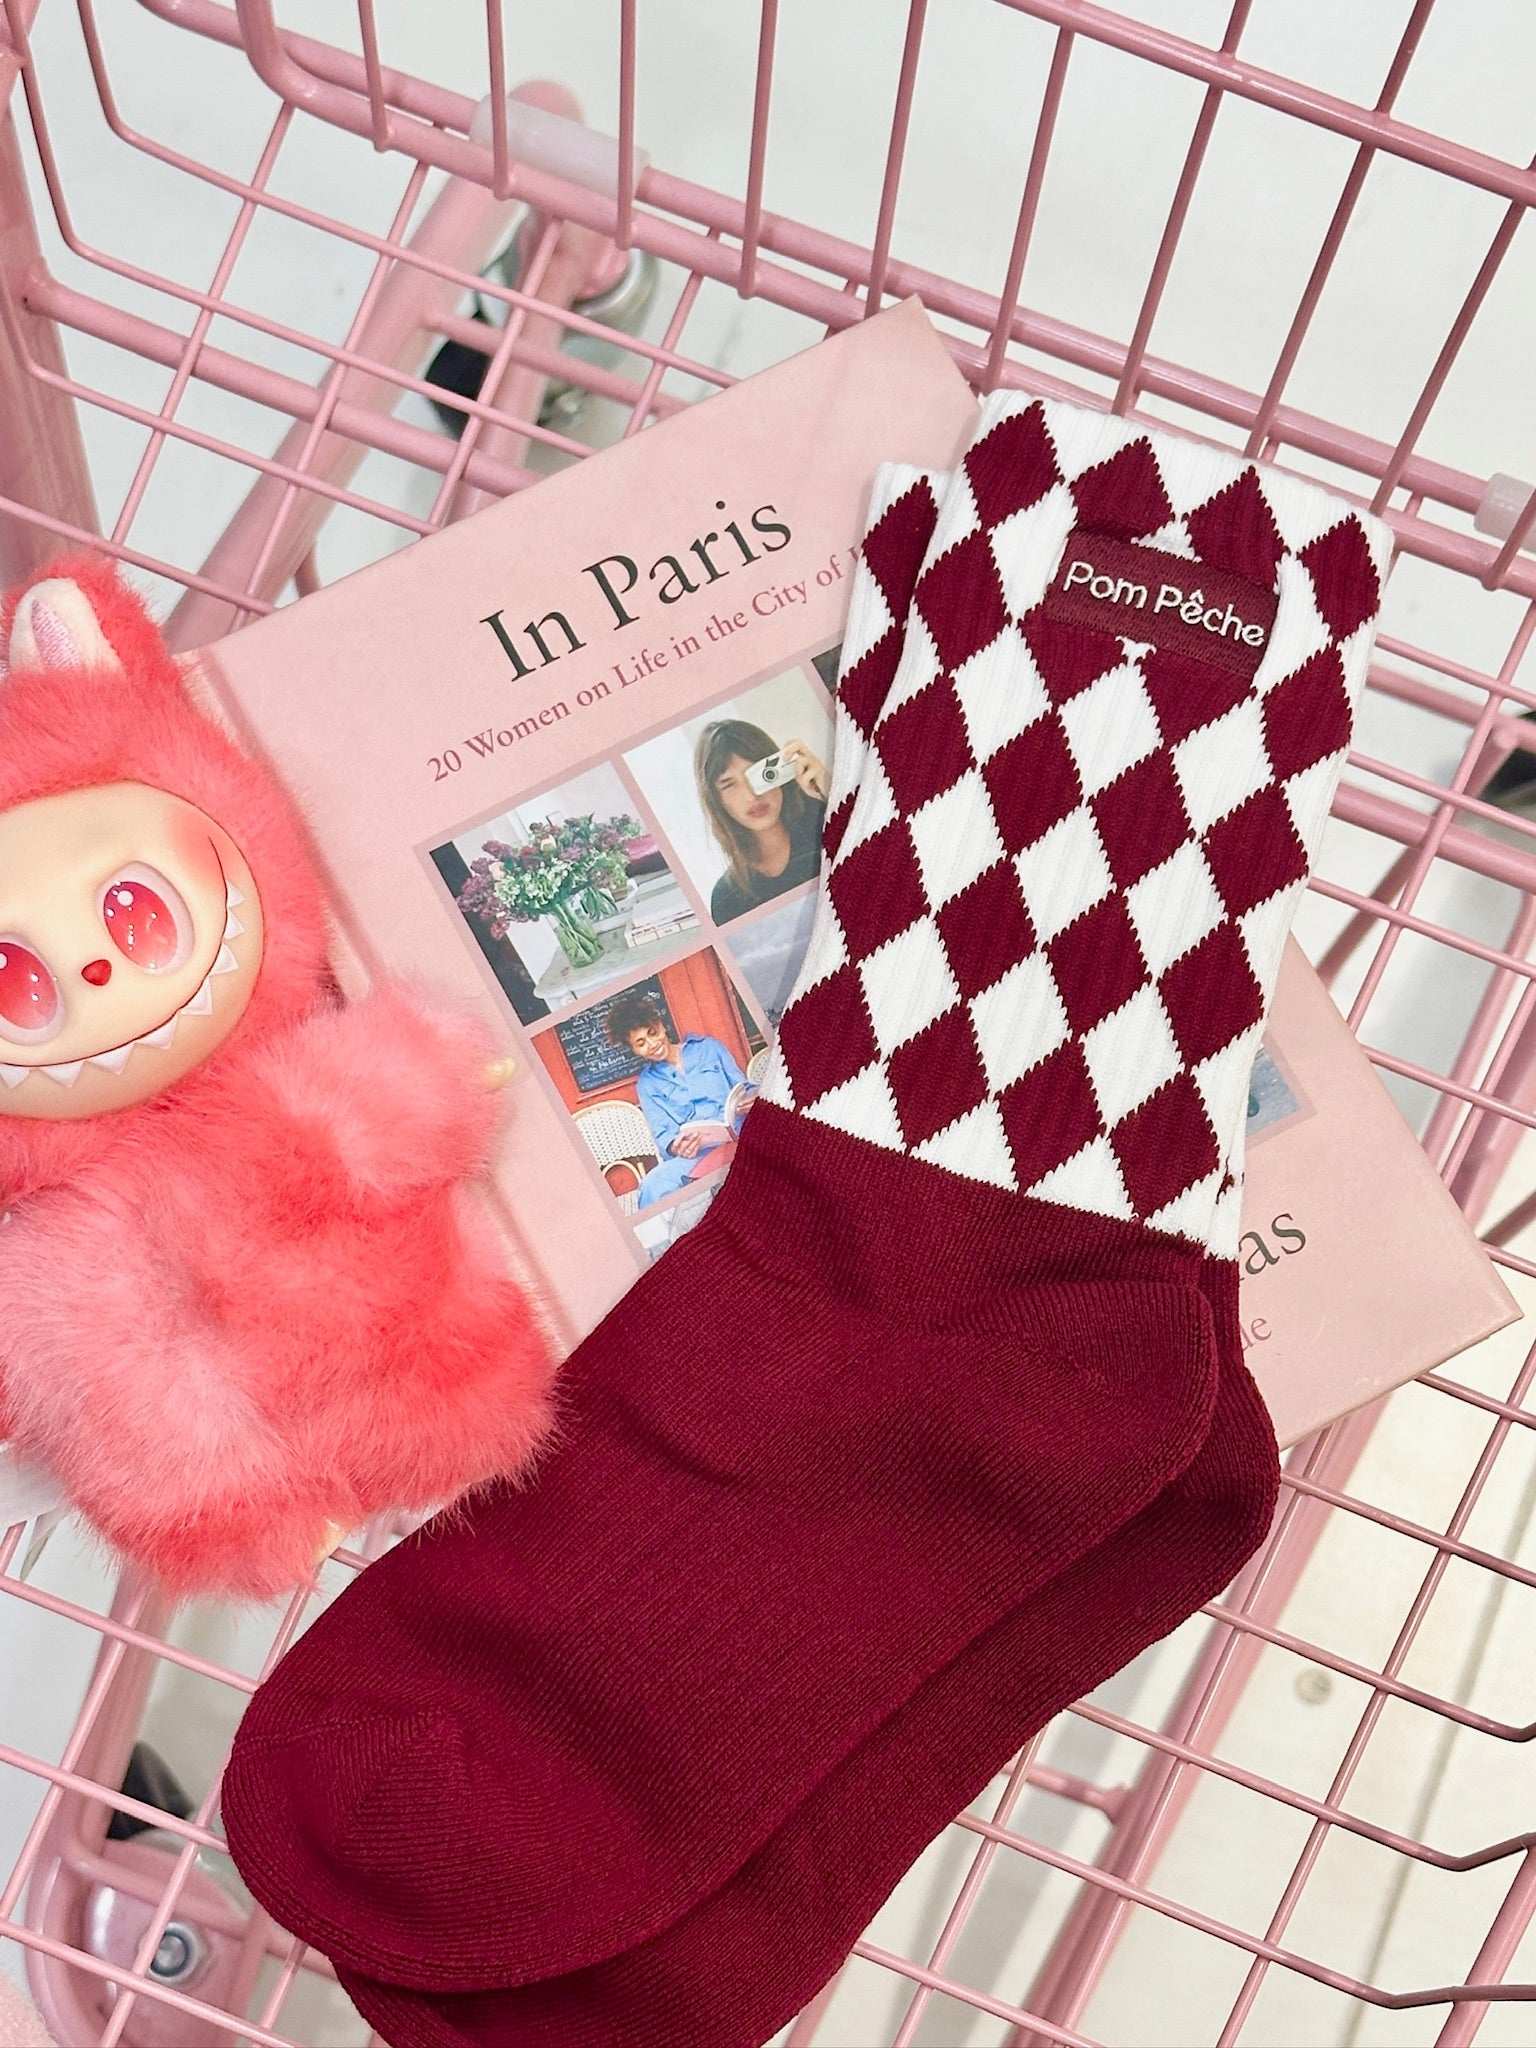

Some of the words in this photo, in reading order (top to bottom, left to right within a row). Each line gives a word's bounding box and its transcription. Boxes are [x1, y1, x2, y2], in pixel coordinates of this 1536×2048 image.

[479, 609, 587, 682] In
[581, 500, 792, 631] Paris
[1062, 560, 1148, 609] Pom
[1153, 584, 1265, 647] Pêche
[427, 749, 462, 783] 20
[463, 701, 572, 760] Women
[576, 681, 612, 707] on
[612, 647, 670, 689] Life
[670, 634, 702, 660] in
[704, 611, 749, 642] the
[752, 581, 808, 617] City
[815, 553, 844, 587] of
[1239, 1213, 1307, 1281] as
